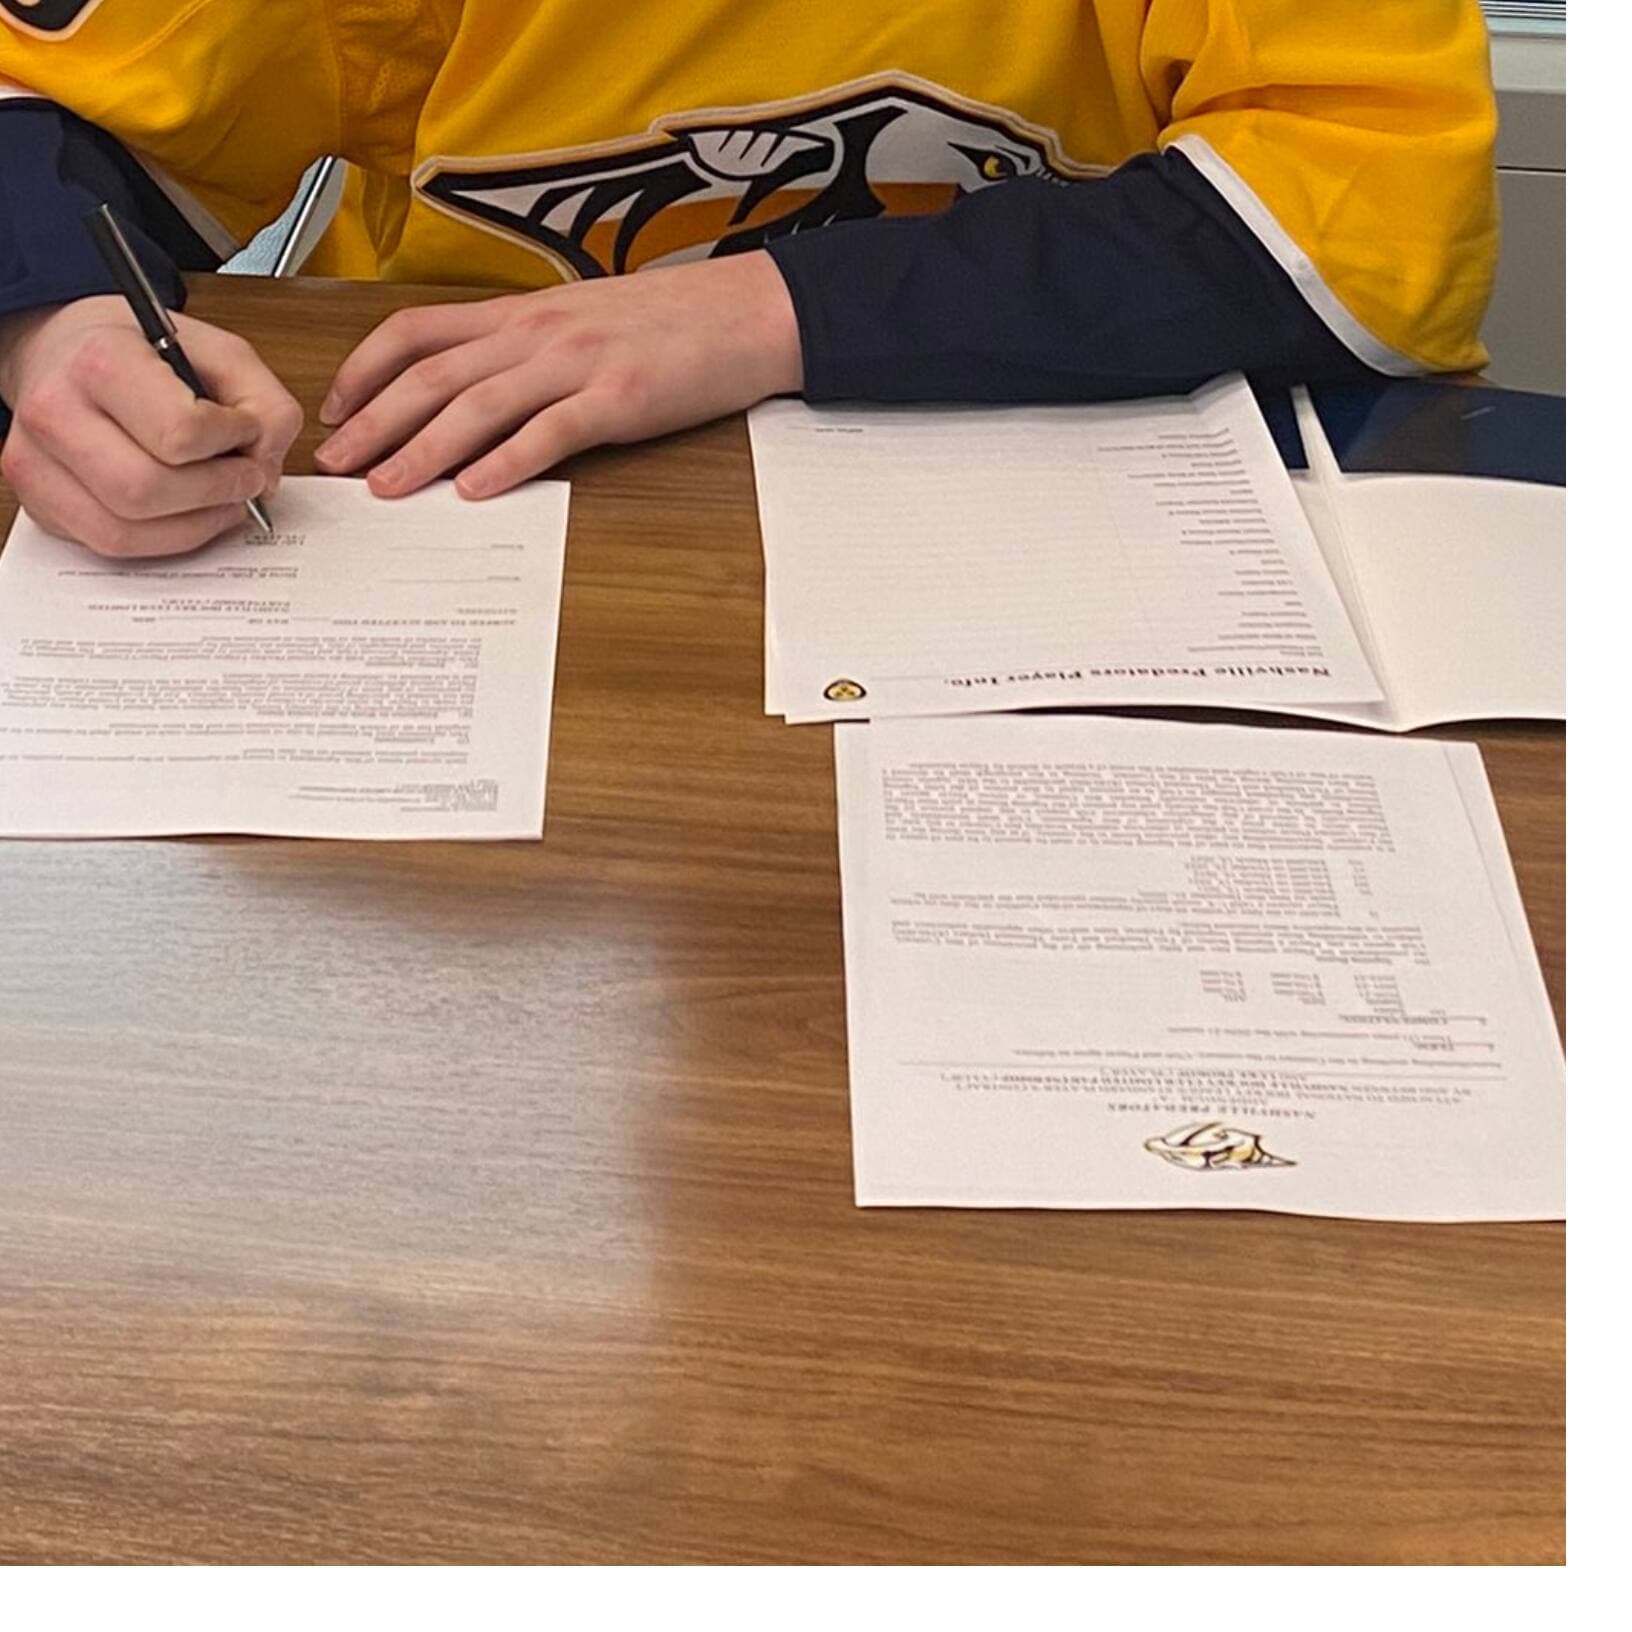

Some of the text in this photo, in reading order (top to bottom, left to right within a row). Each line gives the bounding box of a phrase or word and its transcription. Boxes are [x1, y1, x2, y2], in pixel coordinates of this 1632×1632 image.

[942, 666, 1331, 687] Nashville Predators Player Info.
